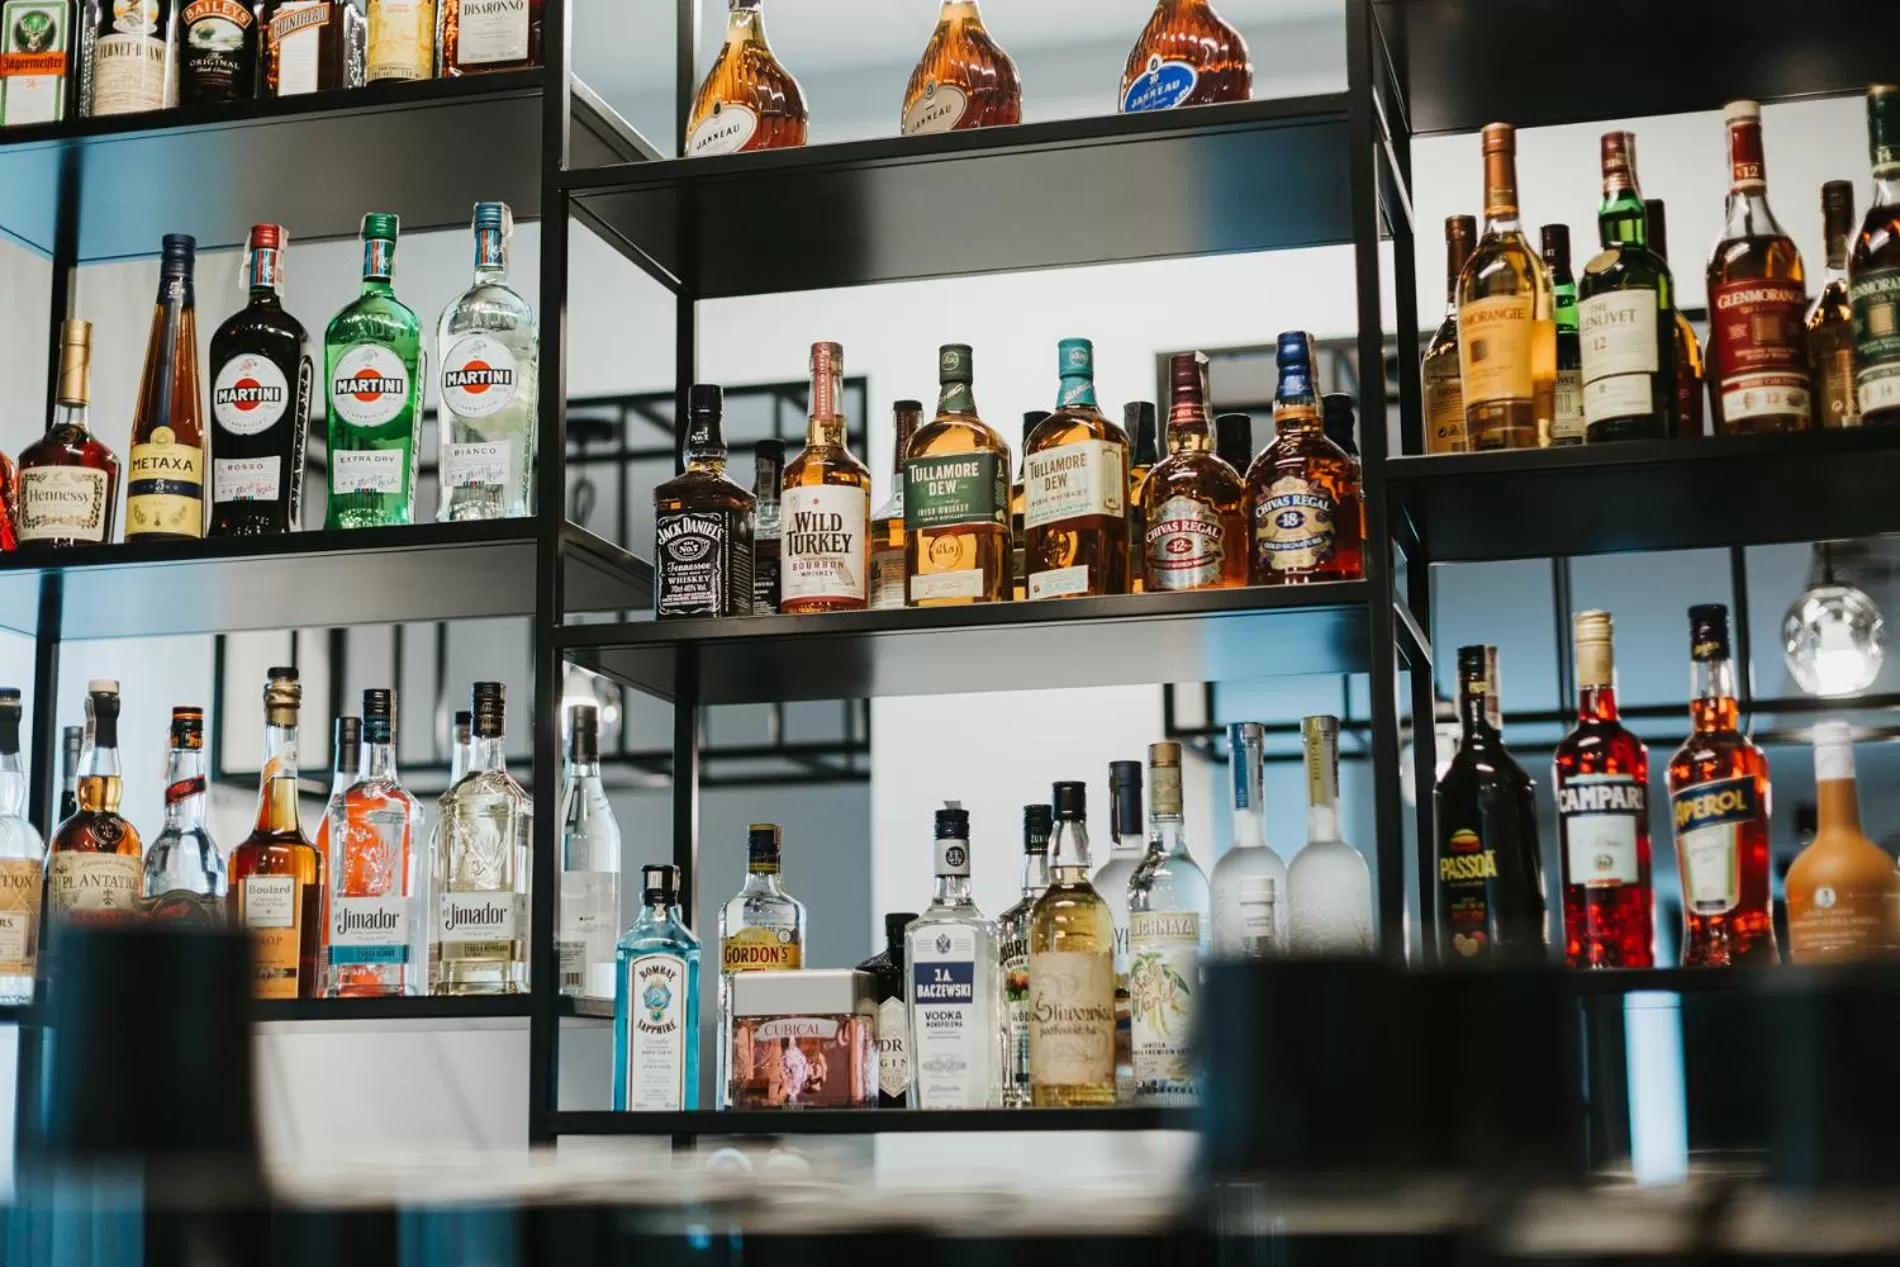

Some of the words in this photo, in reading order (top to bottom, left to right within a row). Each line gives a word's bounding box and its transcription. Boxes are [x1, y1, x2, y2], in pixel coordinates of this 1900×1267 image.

[185, 0, 249, 23] BAILEYS
[464, 1, 524, 16] DISARONNO
[189, 60, 240, 70] ORIGINAL
[1131, 79, 1181, 109] JANNEAU
[911, 103, 952, 132] JANNEAU
[696, 123, 740, 151] JANNEAU
[447, 370, 511, 386] MARTINI
[337, 379, 402, 394] MARTINI
[218, 388, 280, 403] MARTINI
[340, 455, 372, 464] EXTRA
[374, 455, 395, 463] DRY
[453, 447, 496, 457] BIANCO
[132, 457, 193, 473] METAXA
[227, 463, 264, 471] ROSSO
[909, 462, 979, 484] TULLAMORE
[1029, 453, 1087, 481] TULLAMORE
[928, 479, 957, 497] DEW
[1044, 473, 1068, 492] DEW
[29, 487, 90, 503] Hennessy
[1255, 495, 1290, 518] CHIVAS
[1292, 494, 1331, 512] REGAL
[794, 511, 843, 533] WILD
[1282, 512, 1299, 527] 18
[657, 522, 682, 545] JACK
[682, 517, 725, 541] DANIEL'S
[1146, 521, 1179, 543] CHIVAS
[1181, 520, 1219, 539] REGAL
[786, 530, 853, 557] TURKEY
[1172, 539, 1186, 552] 12
[667, 562, 711, 572] Tennessee
[792, 560, 845, 571] BOURBON
[668, 575, 710, 584] WHISKEY
[1559, 785, 1645, 813] CAMPARI
[1675, 790, 1748, 827] APEROL
[248, 884, 291, 894] Boulard
[337, 907, 400, 935] Jimador
[445, 901, 508, 931] Jimador
[724, 945, 788, 964] GORDON'S
[639, 964, 677, 983] BOMBAY
[917, 983, 971, 998] BACZEWSKI
[925, 1011, 962, 1021] VODKA
[636, 1019, 678, 1035] SAPPHIRE
[764, 1023, 820, 1036] CUBICAL
